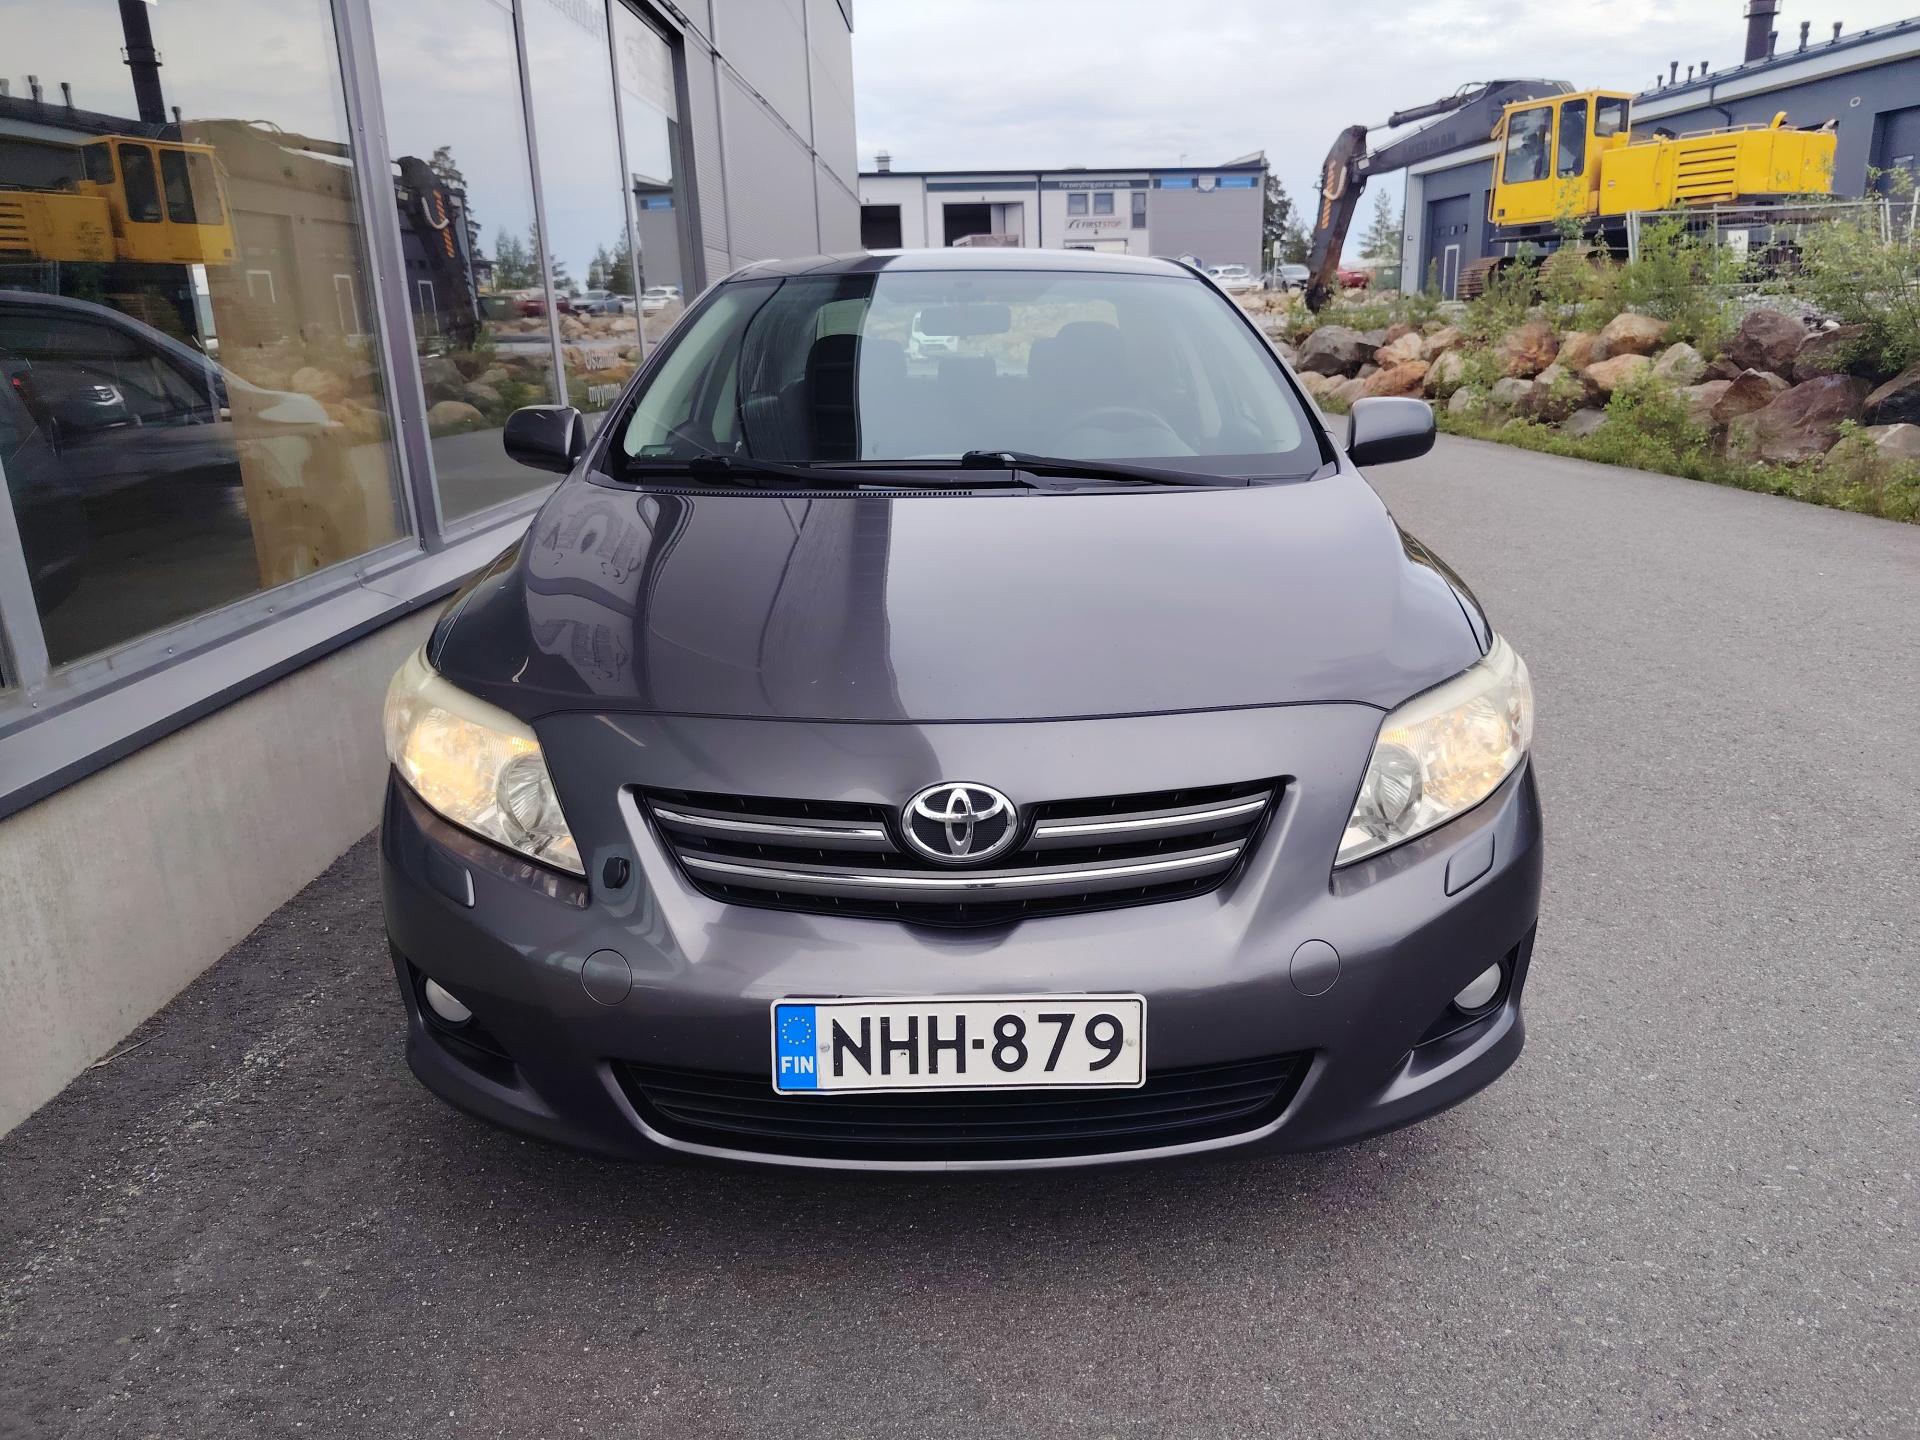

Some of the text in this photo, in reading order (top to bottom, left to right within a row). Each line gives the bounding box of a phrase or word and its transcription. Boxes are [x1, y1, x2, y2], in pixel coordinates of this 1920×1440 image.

[1081, 220, 1122, 229] FIRST STOP
[831, 1013, 1124, 1077] NHH-879
[780, 1056, 814, 1075] FIN
